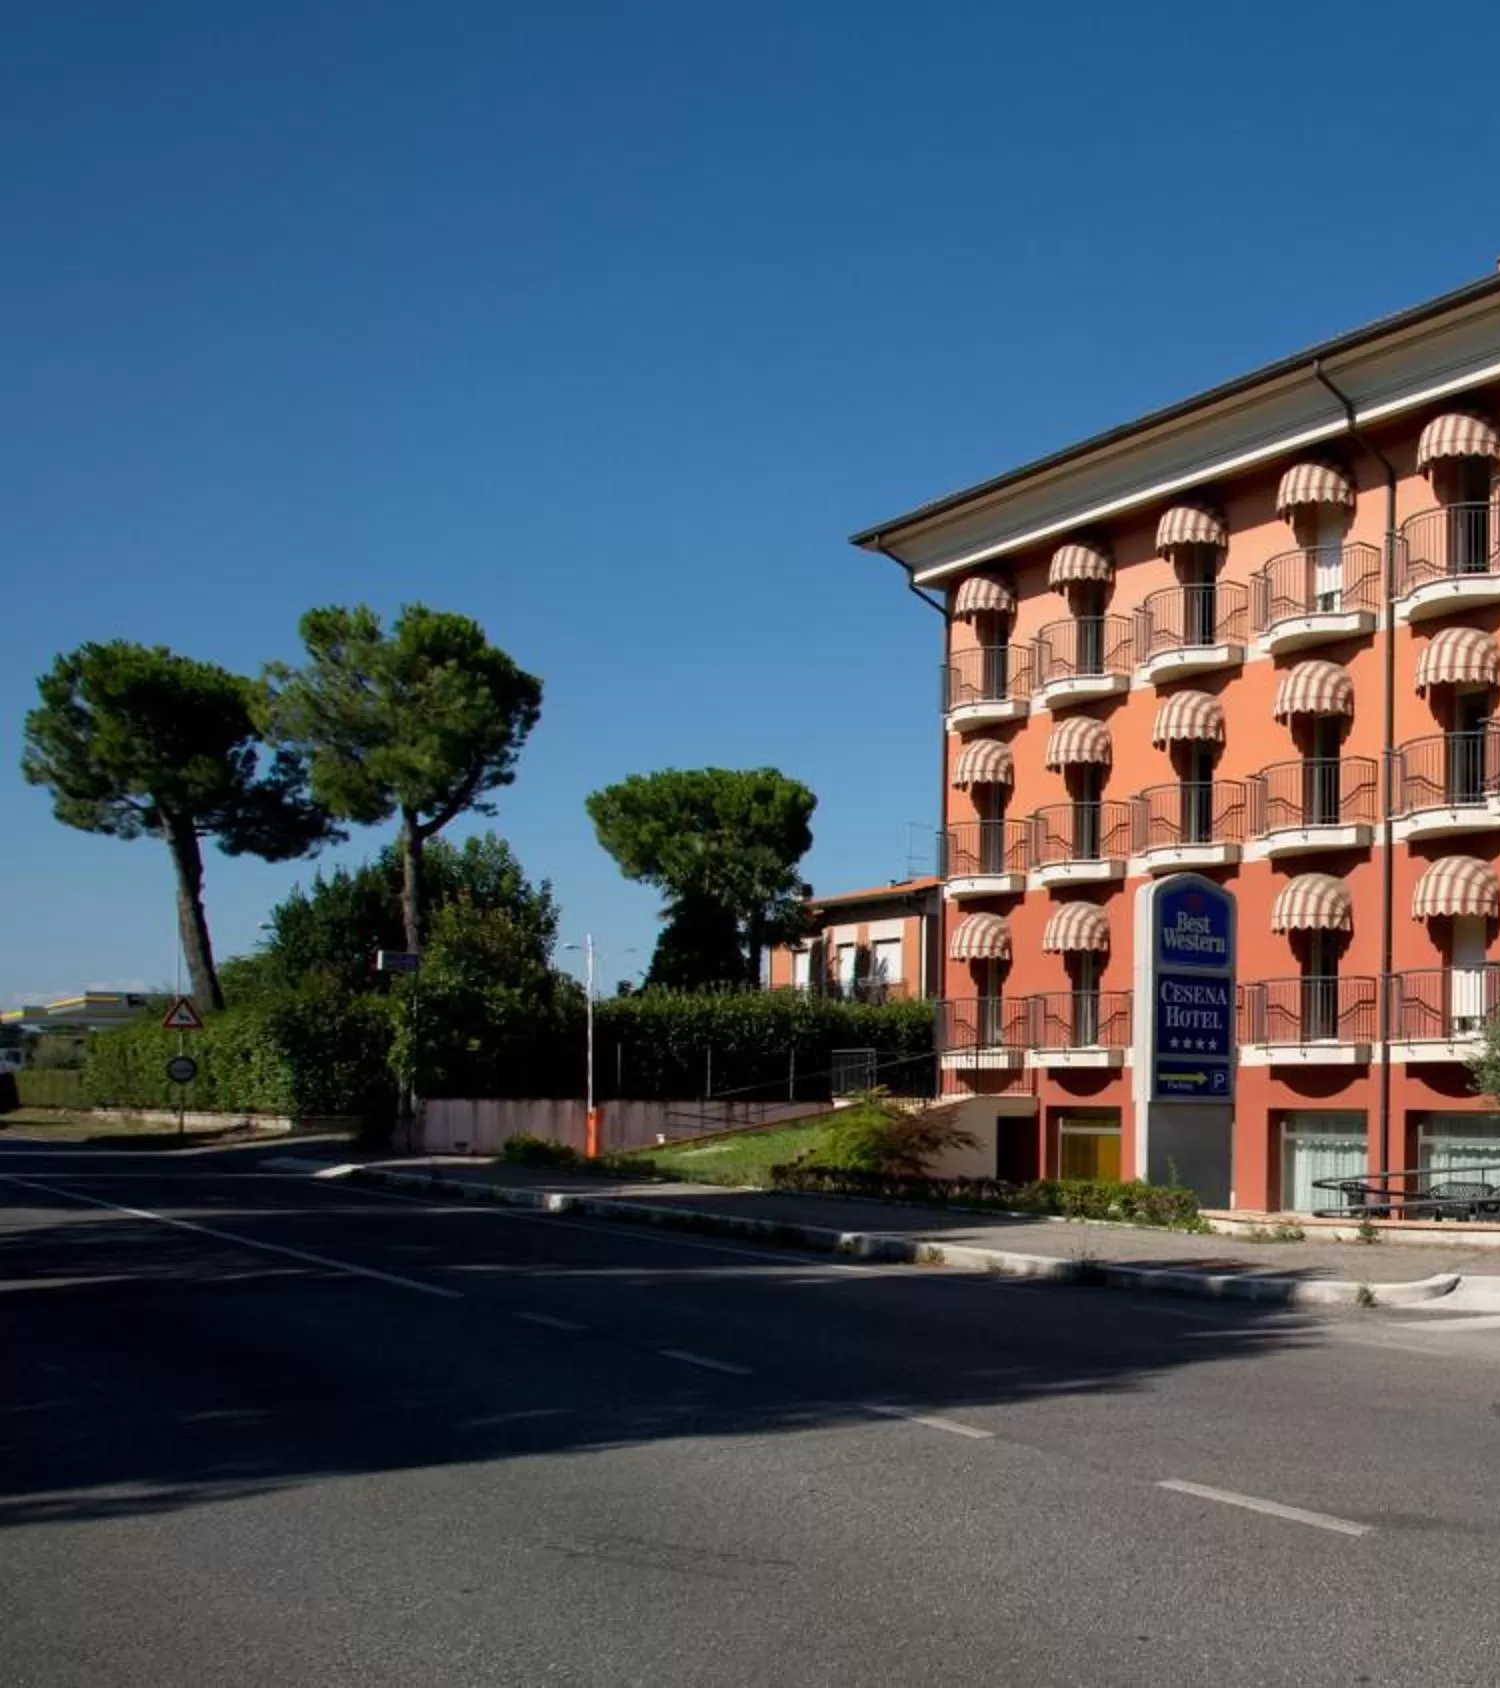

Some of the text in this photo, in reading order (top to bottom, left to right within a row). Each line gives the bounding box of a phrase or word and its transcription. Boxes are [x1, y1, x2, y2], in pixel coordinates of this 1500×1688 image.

[1177, 911, 1211, 934] Best
[1163, 927, 1225, 953] Western
[1160, 980, 1227, 1005] CESENA
[1165, 1005, 1223, 1030] HOTEL
[1213, 1073, 1225, 1089] P
